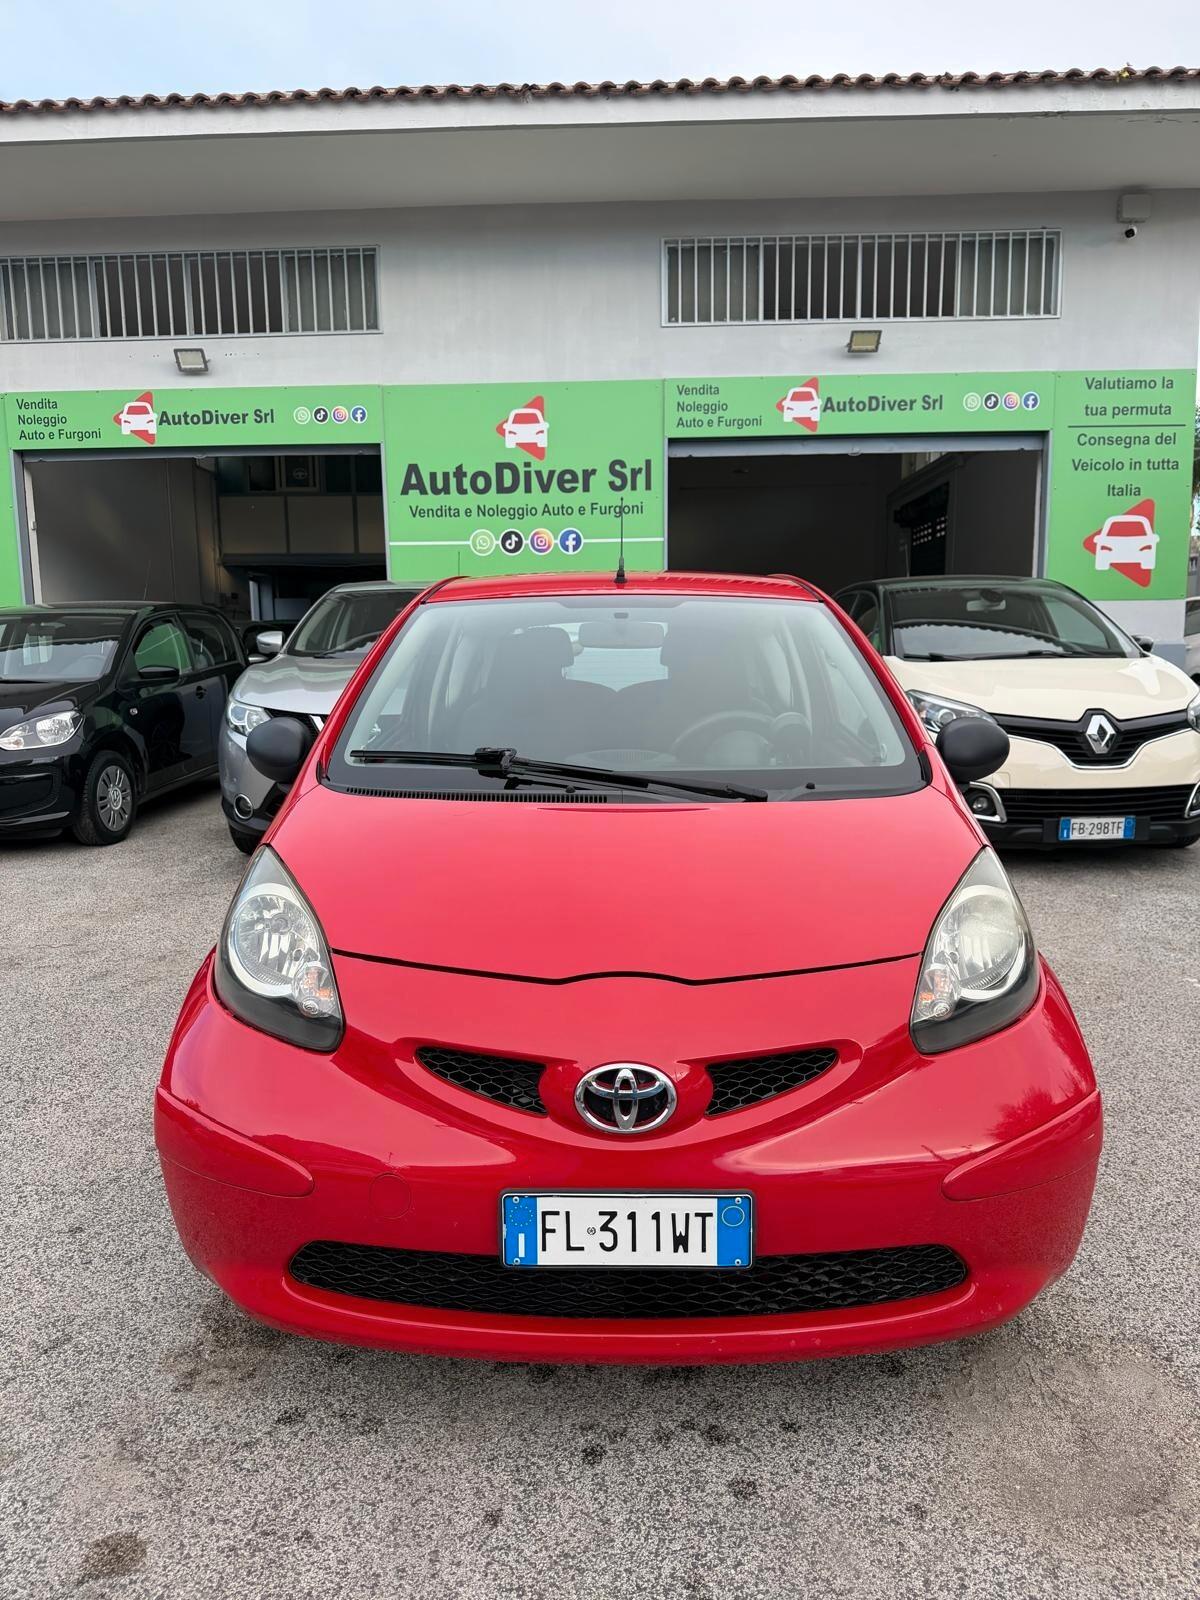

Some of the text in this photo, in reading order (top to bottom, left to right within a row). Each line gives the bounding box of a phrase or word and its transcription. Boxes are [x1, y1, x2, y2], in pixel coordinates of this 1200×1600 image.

[1085, 376, 1174, 390] Valutiamo la
[677, 385, 720, 396] Vendita
[16, 398, 58, 410] Vendita
[677, 401, 728, 413] Noleggio
[822, 394, 944, 413] AutoDiver Srl
[158, 408, 275, 426] AutoDiver Srl
[1085, 404, 1172, 419] tua permuta
[18, 414, 67, 426] Noleggio
[677, 416, 762, 429] Auto e Furgoni
[19, 428, 101, 441] Auto e Furgoni
[1077, 432, 1176, 448] Consegna del
[1072, 458, 1179, 471] Veicolo in tutta
[400, 459, 652, 496] AutoDiver Srl
[1107, 484, 1141, 496] Italia
[409, 501, 644, 520] Vendita e Noleggio Auto e Furgoni
